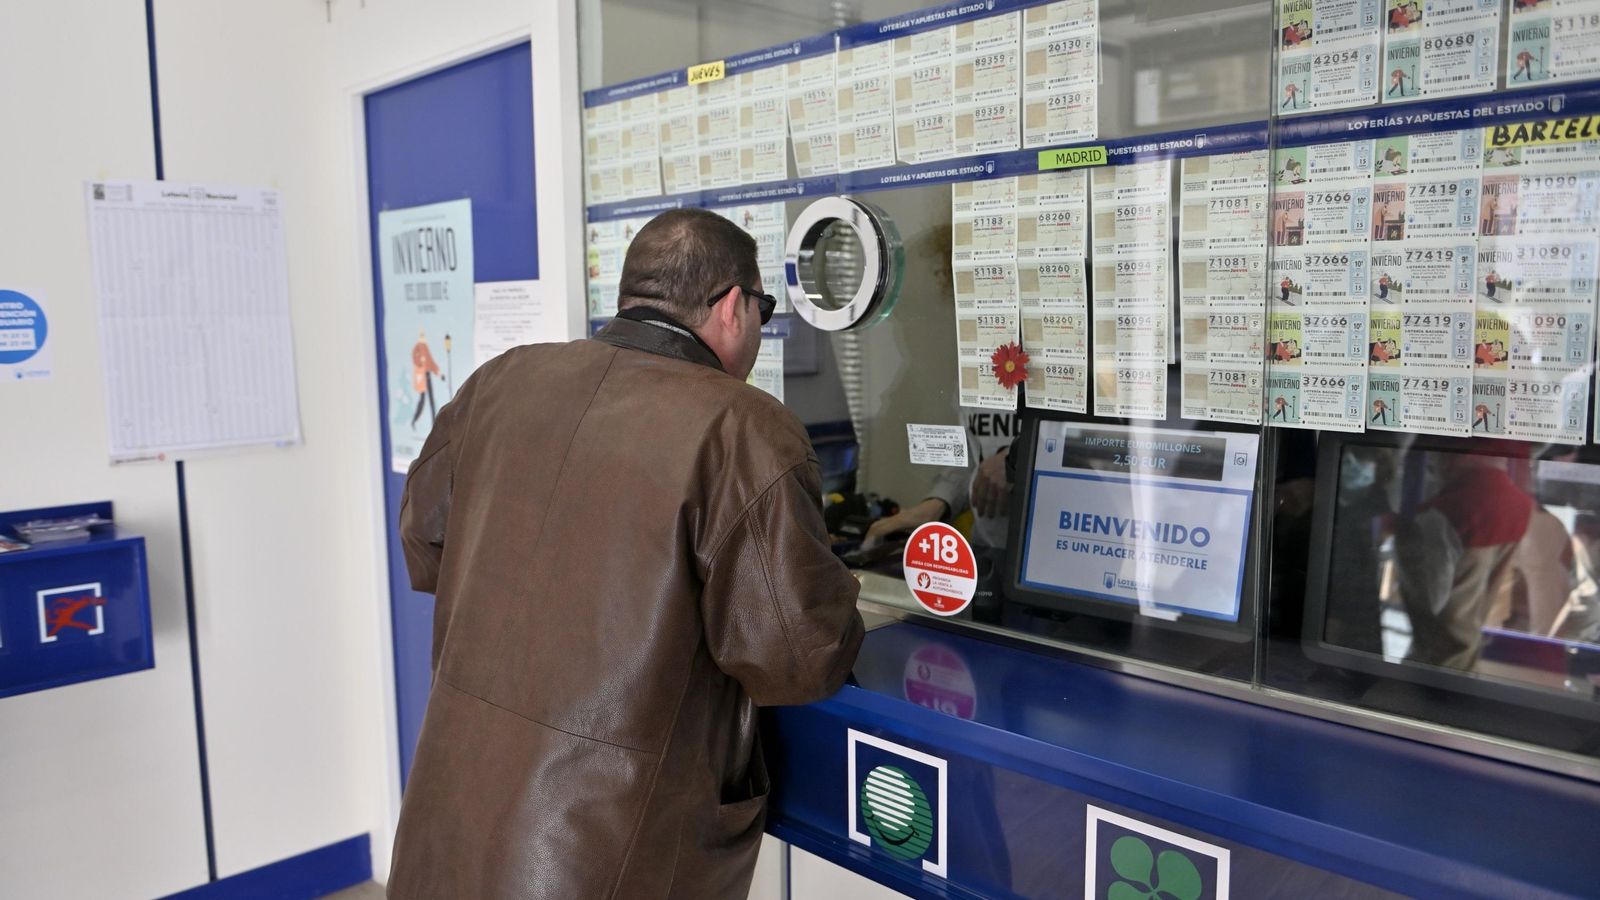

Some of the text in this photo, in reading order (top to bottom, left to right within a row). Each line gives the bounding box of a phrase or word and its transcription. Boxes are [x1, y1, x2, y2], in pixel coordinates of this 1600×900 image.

[1512, 26, 1549, 42] INVIERNO
[1048, 39, 1081, 53] 26130
[1424, 34, 1475, 50] 80680
[975, 54, 1005, 67] 89359
[1313, 50, 1359, 66] 42054
[1387, 46, 1421, 62] INVIERNO
[1281, 61, 1312, 76] INVIERNO
[1048, 93, 1081, 107] 26130
[975, 105, 1005, 118] 89359
[1348, 102, 1545, 131] LOTERÍAS Y APUESTAS DEL ESTADO
[1143, 144, 1158, 152] DEL
[1160, 139, 1193, 150] ESTADO
[1056, 150, 1102, 165] MADRID
[1409, 183, 1458, 196] 77419
[1482, 182, 1517, 196] INVIERNO
[1307, 193, 1351, 204] 37666
[1373, 190, 1405, 204] INVIERNO
[1210, 198, 1249, 210] 71081
[1276, 198, 1304, 210] INVIERNO
[1038, 211, 1071, 222] 68260
[1117, 205, 1152, 217] 56094
[974, 217, 1004, 227] 51183
[1304, 255, 1349, 265] 37666
[1405, 249, 1454, 262] 77419
[1478, 251, 1513, 264] INVIERNO
[1516, 246, 1571, 261] 31090
[1117, 261, 1151, 272] 56094
[1209, 257, 1247, 268] 71081
[1371, 255, 1402, 267] INVIERNO
[974, 267, 1004, 278] 51183
[1038, 264, 1071, 274] 68260
[977, 316, 1006, 325] 51183
[1043, 316, 1073, 325] 68260
[1117, 316, 1151, 326] 56094
[1209, 315, 1247, 325] 71081
[1272, 318, 1301, 331] INVIERNO
[1303, 315, 1348, 326] 37666
[1370, 318, 1400, 330] INVIERNO
[1403, 314, 1451, 327] 77419
[1045, 366, 1075, 375] 68260
[1117, 370, 1151, 381] 56094
[1209, 371, 1247, 382] 71081
[1303, 376, 1345, 387] 37666
[1369, 380, 1400, 392] INVIERNO
[1402, 378, 1449, 391] 77419
[1509, 382, 1562, 394] 31090
[1084, 436, 1202, 455] IMPORTE EUROMILLONES
[1112, 452, 1167, 471] 2,50 EUR
[1059, 509, 1211, 549] BIENVENIDO
[918, 532, 960, 565] +18
[1056, 539, 1209, 571] ES UN PLACER ATENDERLE
